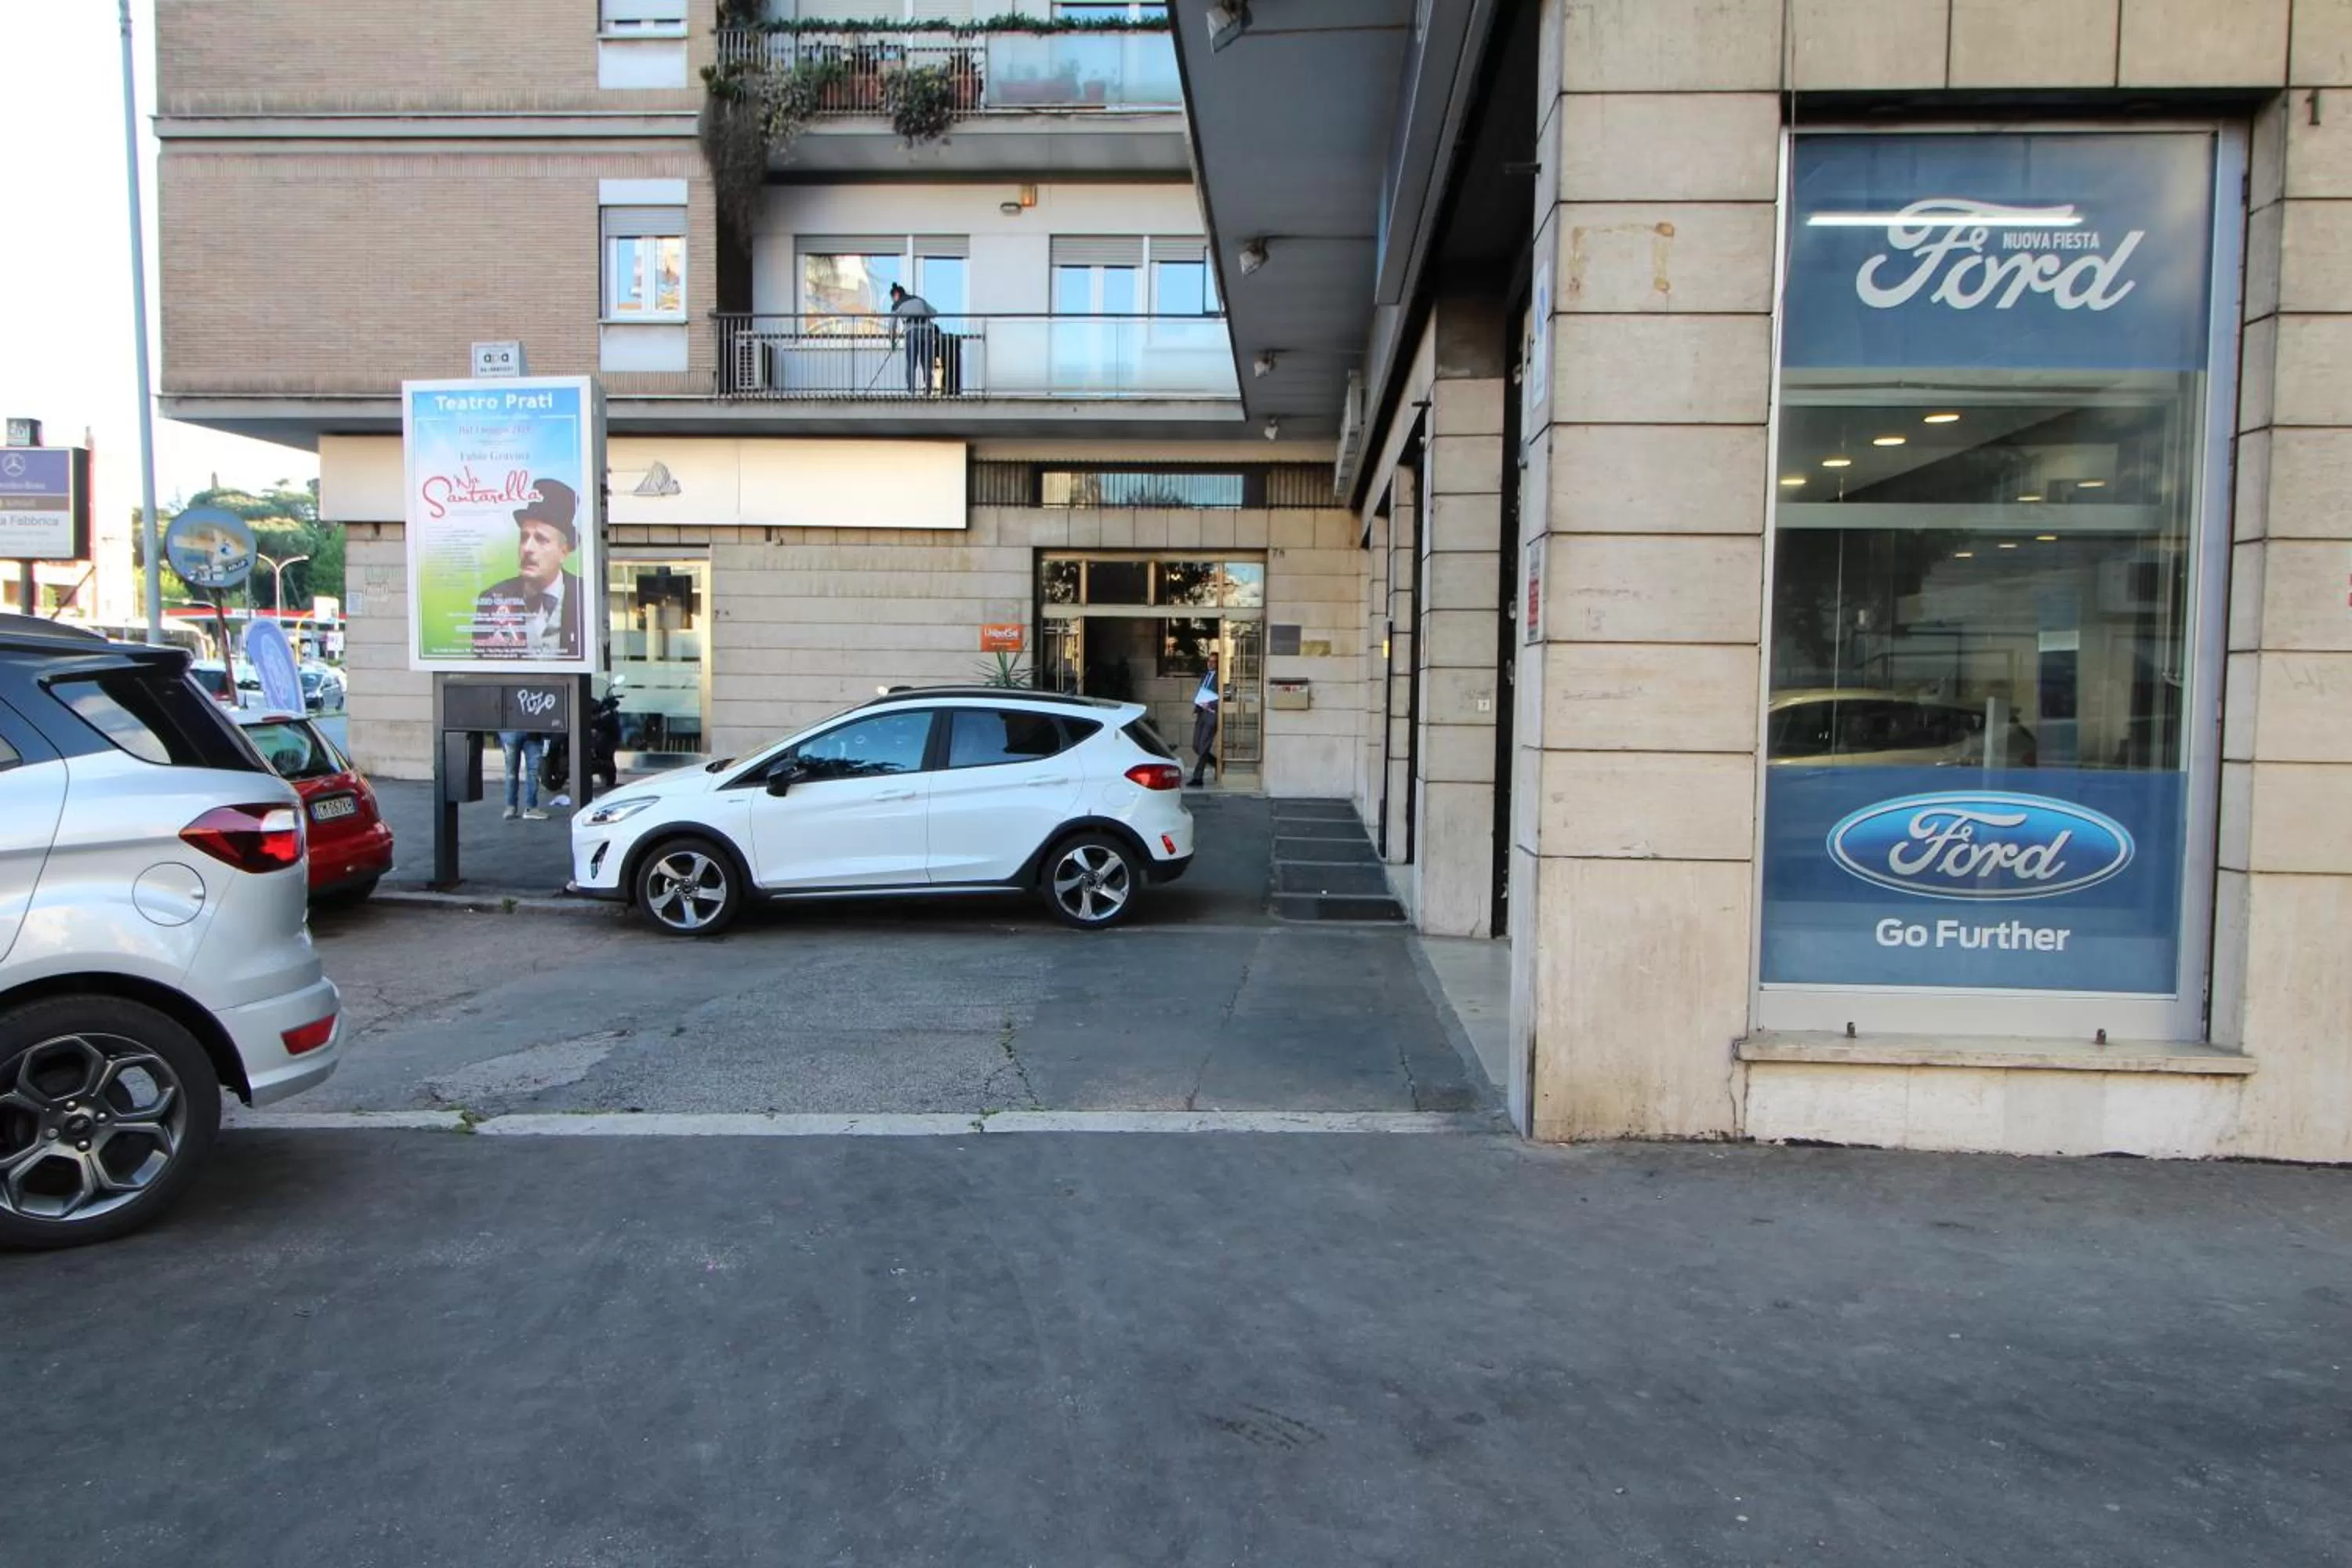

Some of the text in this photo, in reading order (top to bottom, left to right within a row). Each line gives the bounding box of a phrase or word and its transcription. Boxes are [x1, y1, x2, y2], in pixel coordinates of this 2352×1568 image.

[1856, 198, 2145, 310] Ford
[2002, 231, 2100, 249] NUOVA FIESTA
[436, 393, 554, 411] Teatro Prati
[423, 470, 543, 518] Santarella
[10, 516, 59, 527] Fabbrica
[1888, 808, 2073, 881] Ford
[1875, 918, 2071, 952] Go Further
